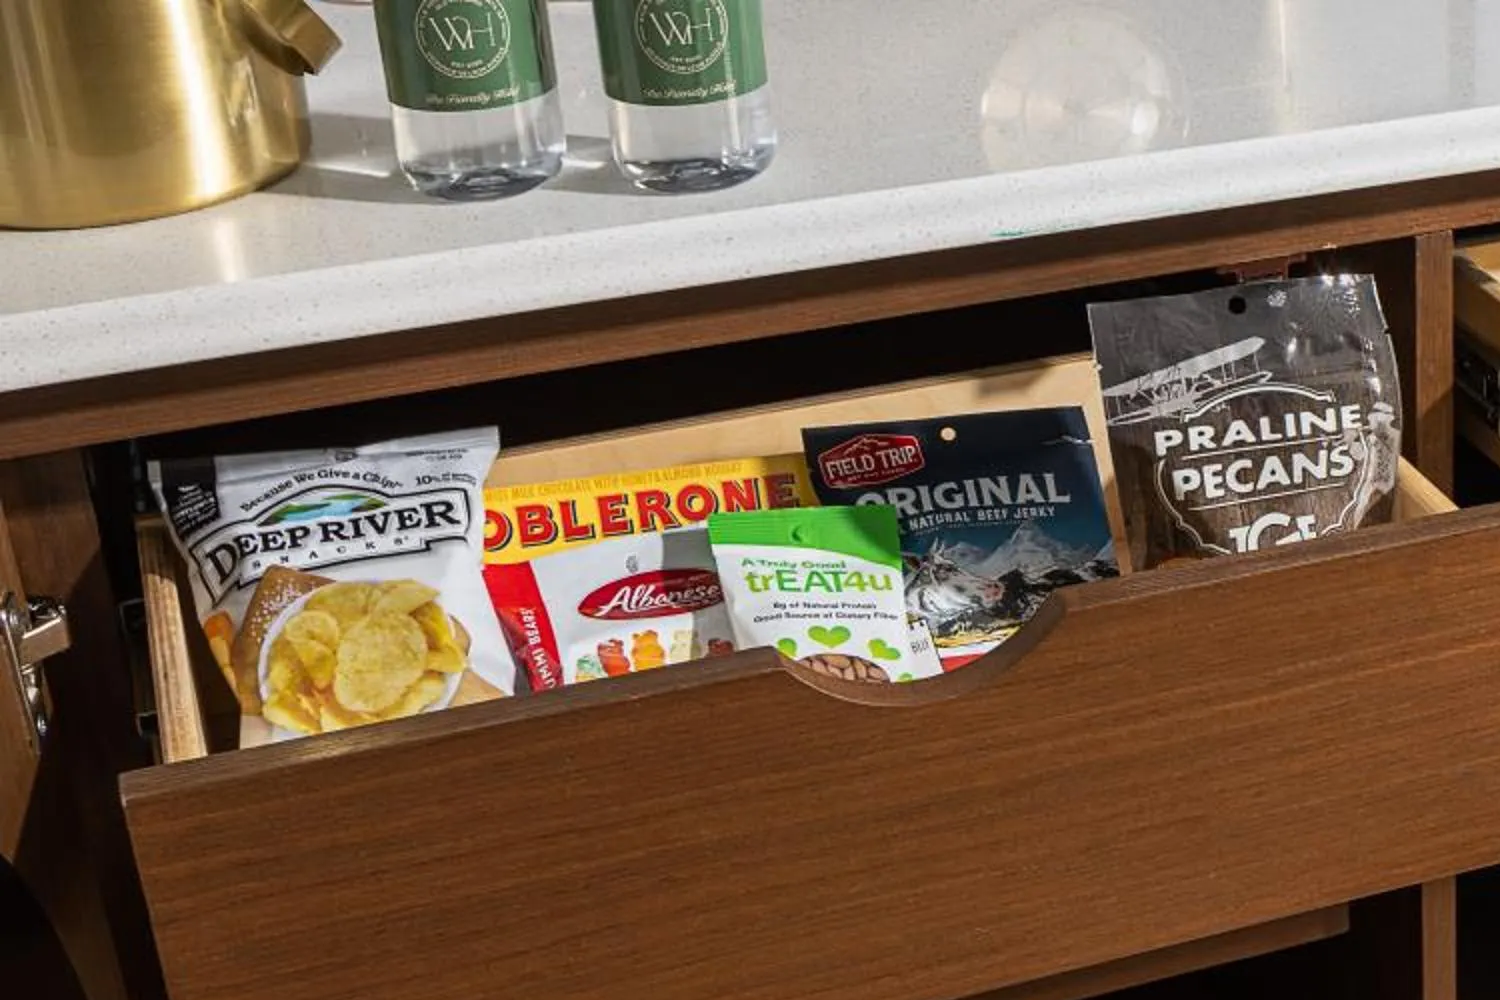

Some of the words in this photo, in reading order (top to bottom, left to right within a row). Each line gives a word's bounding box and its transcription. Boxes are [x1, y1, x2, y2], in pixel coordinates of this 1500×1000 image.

[1154, 404, 1363, 456] PRALINE
[825, 454, 876, 479] FIELD
[875, 445, 915, 468] TRIP
[1172, 444, 1354, 501] PECANS
[240, 480, 293, 512] Because
[293, 471, 315, 484] We
[317, 468, 351, 480] Give
[351, 472, 360, 480] a
[483, 472, 800, 552] OBLERONE
[909, 511, 971, 530] NATURAL
[977, 508, 1009, 521] BEEF
[1013, 506, 1055, 519] JERKY
[206, 525, 312, 584] DEEP
[319, 500, 461, 543] RIVER
[594, 583, 721, 616] Albanese
[745, 569, 893, 593] trEAT4u
